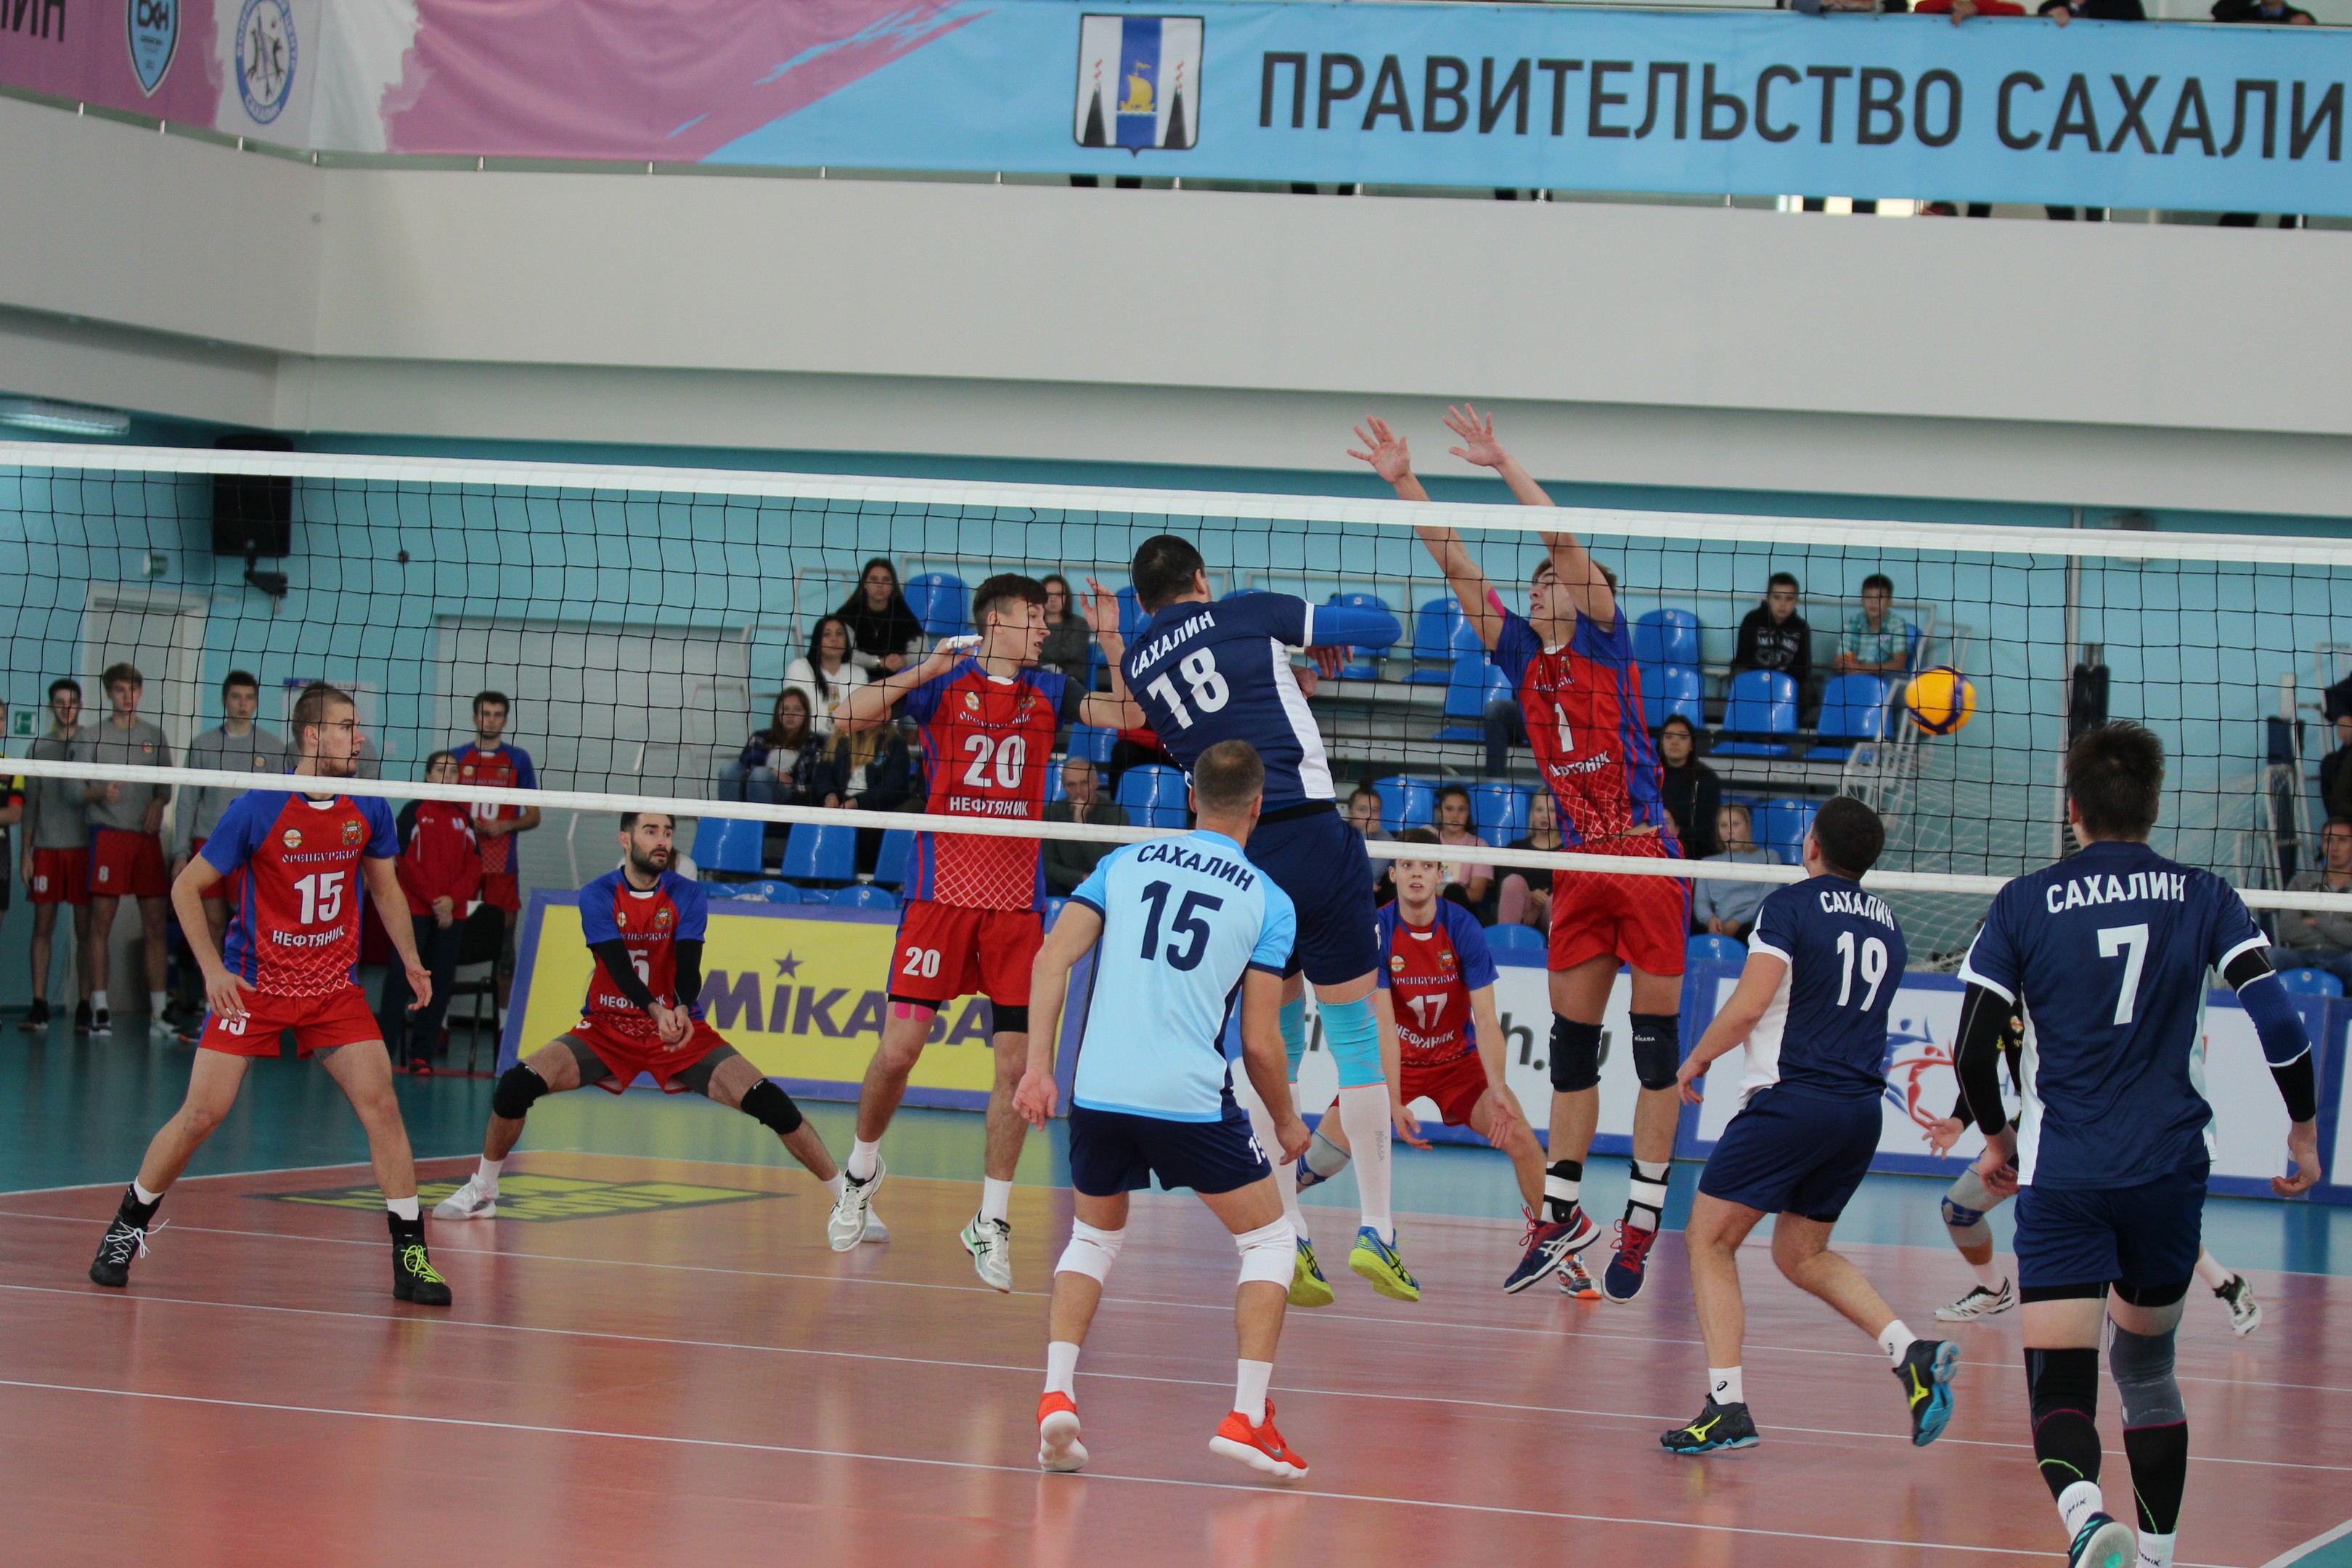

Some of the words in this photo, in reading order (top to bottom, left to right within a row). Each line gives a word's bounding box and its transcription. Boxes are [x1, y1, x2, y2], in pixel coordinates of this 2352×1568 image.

[1259, 51, 1963, 147] ПРАВИТЕЛЬСТВО
[1996, 70, 2345, 161] САХАЛИ
[1131, 611, 1216, 679] САХАЛИН
[1146, 646, 1230, 730] 18
[1554, 702, 1574, 753] 1
[963, 734, 1026, 788] 20
[950, 796, 1029, 816] НЕФТЯНИК
[282, 849, 359, 864] ОРЕНБУРЖЬЕ
[1137, 844, 1255, 891] САХАЛИН
[294, 871, 345, 924] 15
[1819, 891, 1895, 931] САХАЛИН
[2046, 871, 2186, 913] САХАЛИН
[272, 924, 345, 947] НЕФТЯНИК
[1140, 880, 1224, 971] 15
[902, 947, 941, 978] 20
[1837, 931, 1888, 1012] 19
[2097, 923, 2149, 1026] 7
[1406, 992, 1447, 1029] 17
